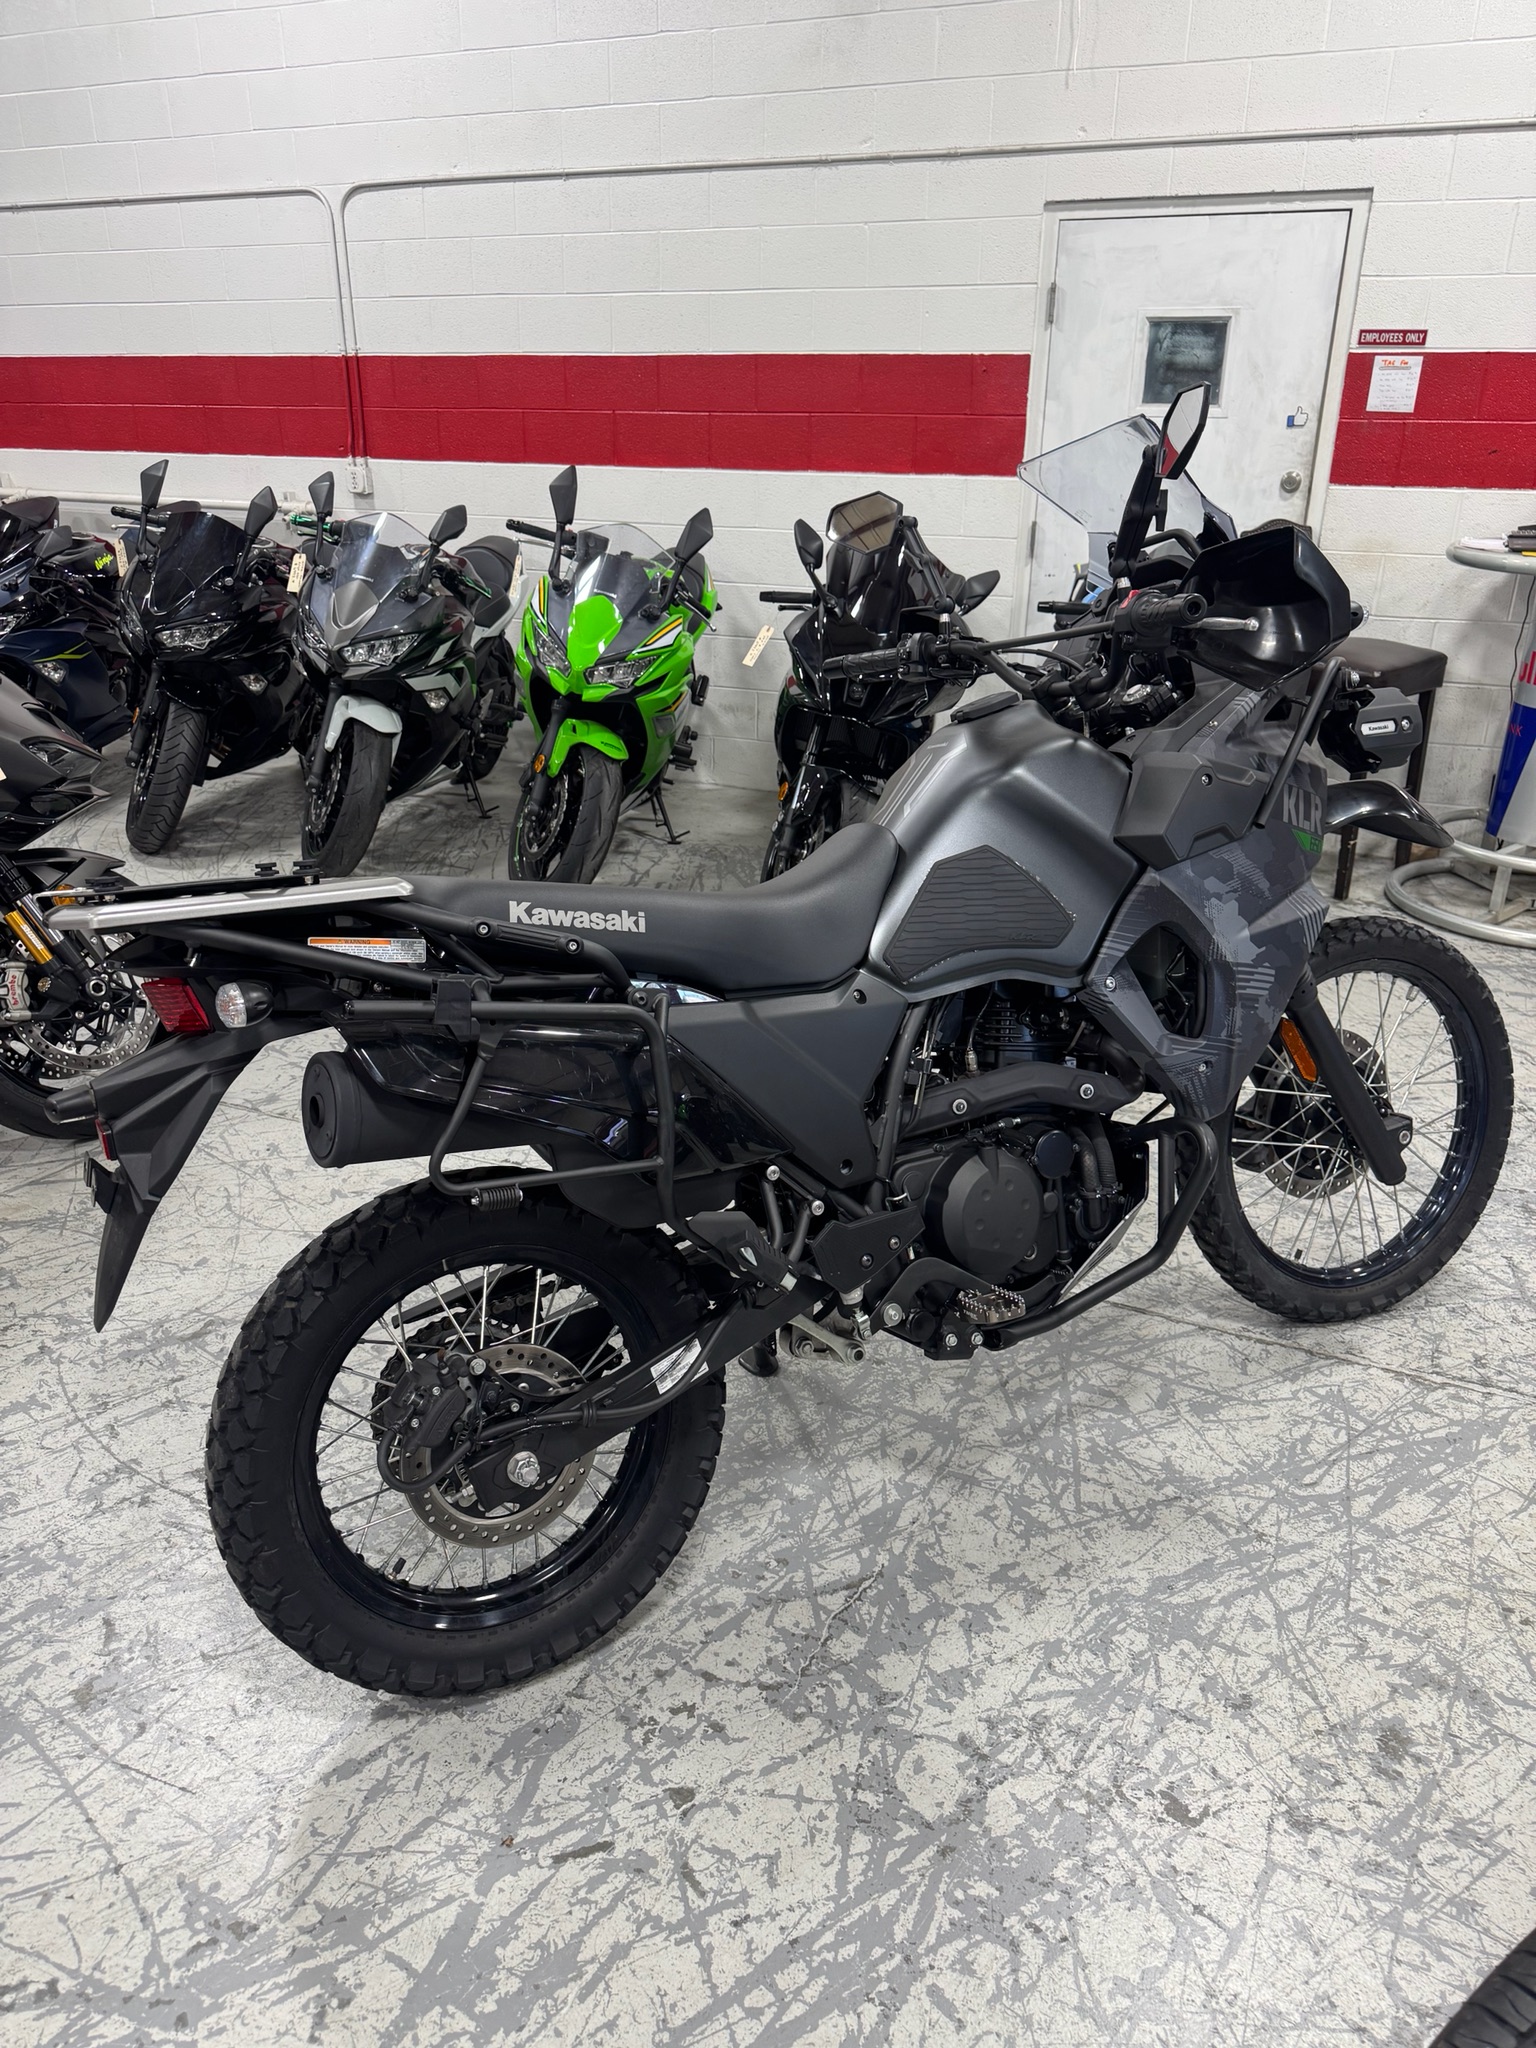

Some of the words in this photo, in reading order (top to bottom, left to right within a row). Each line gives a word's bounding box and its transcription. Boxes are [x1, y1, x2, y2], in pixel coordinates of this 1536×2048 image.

[1360, 332, 1403, 343] EMPLOYEES
[1405, 333, 1425, 343] ONLY
[1368, 724, 1390, 732] Kawasaki
[1282, 783, 1323, 836] KLR
[508, 900, 646, 933] Kawasaki
